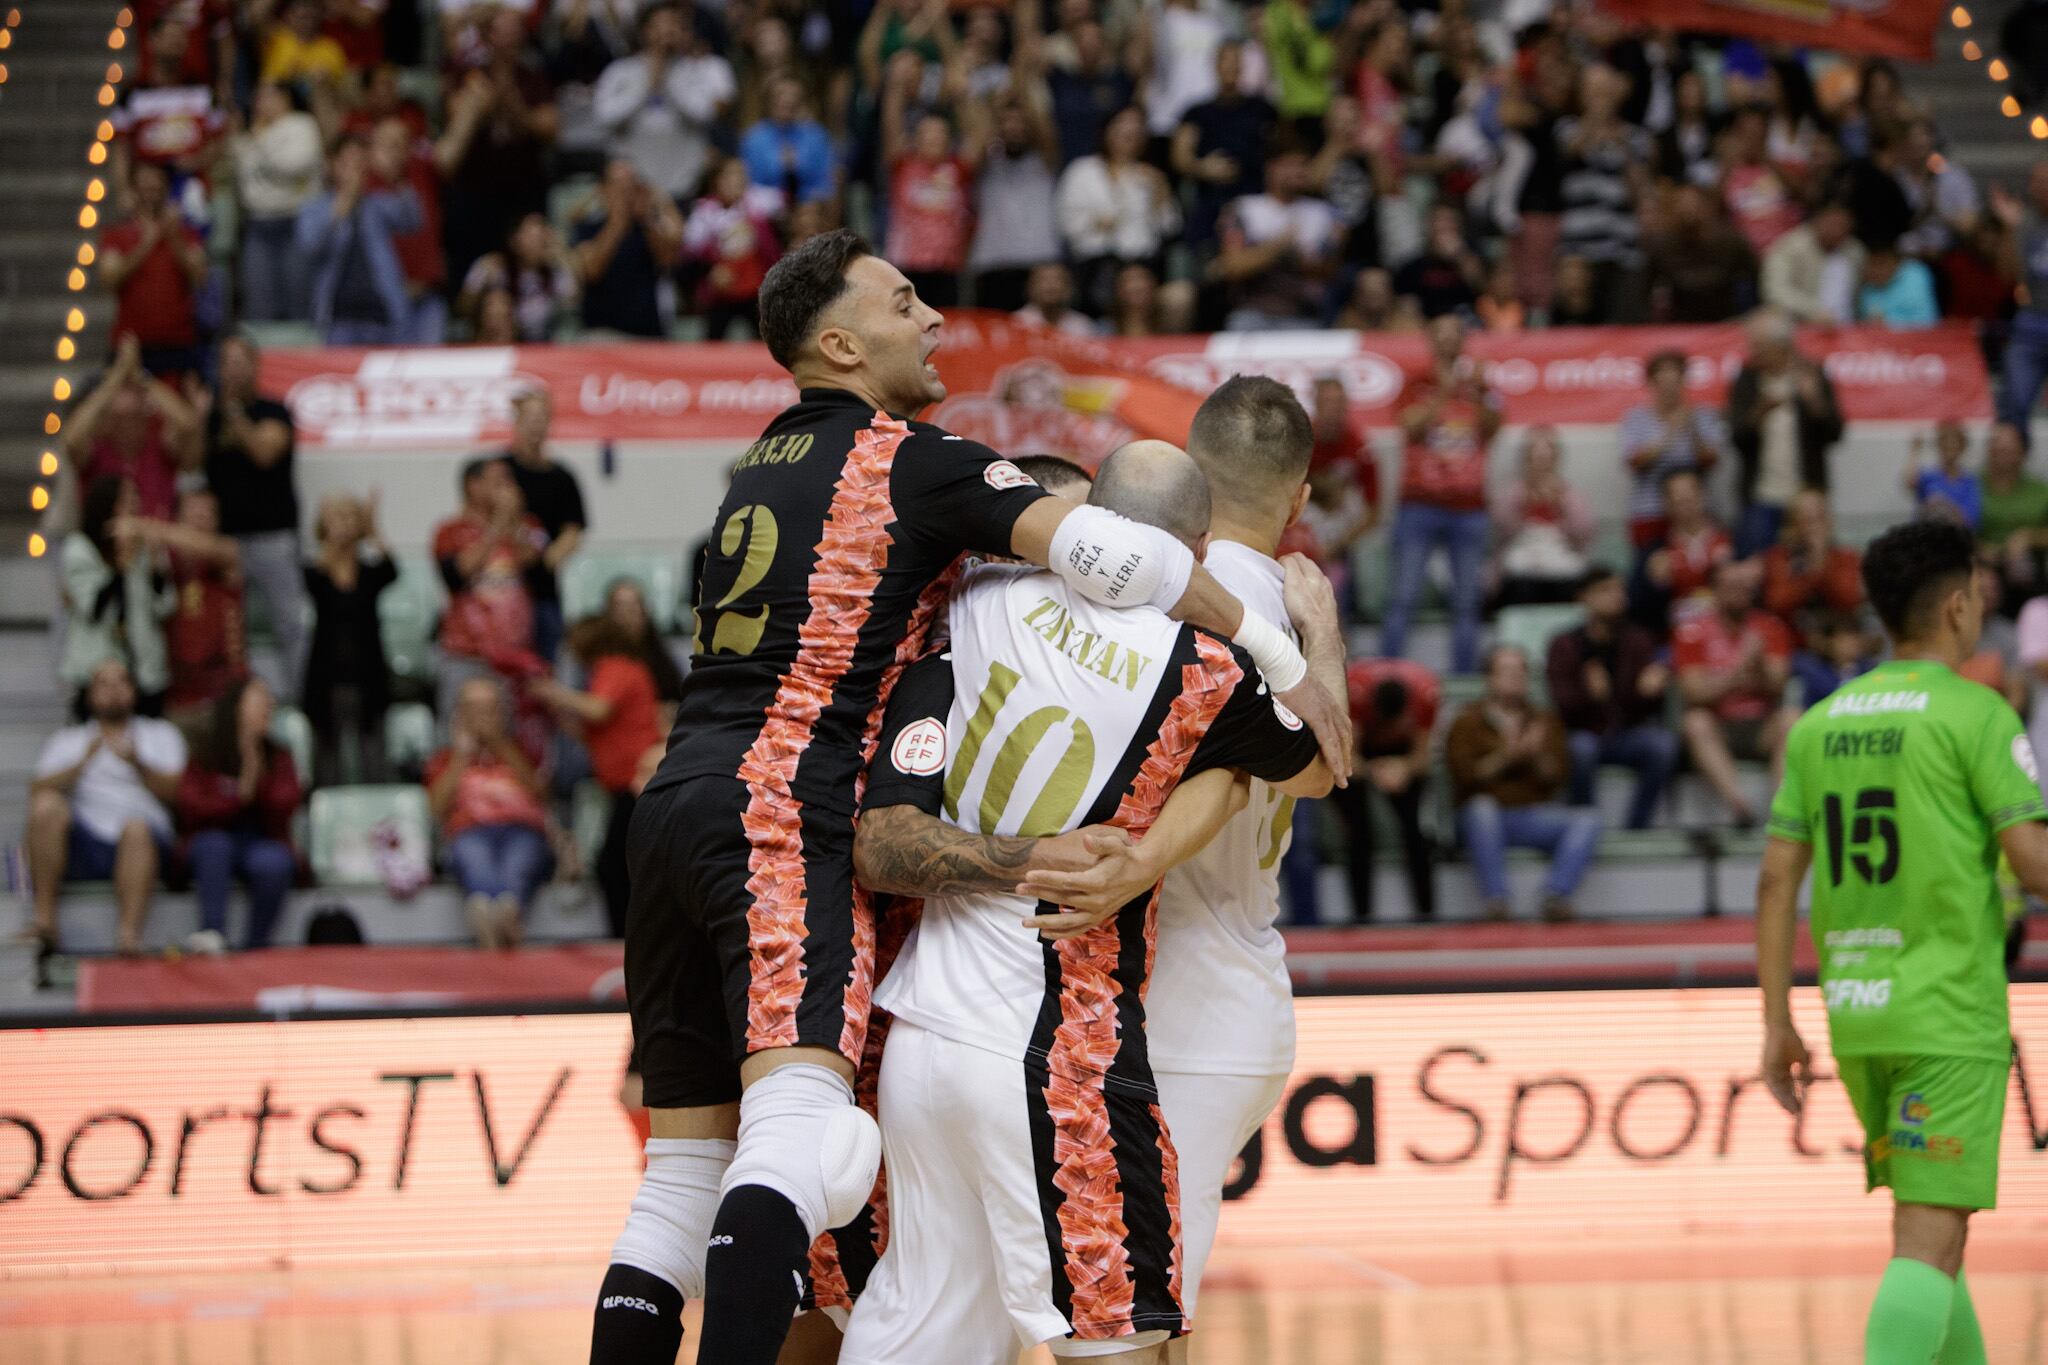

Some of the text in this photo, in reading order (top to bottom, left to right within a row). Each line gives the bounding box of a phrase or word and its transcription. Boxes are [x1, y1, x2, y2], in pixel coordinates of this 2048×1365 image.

[692, 504, 778, 656] 2
[1078, 545, 1104, 575] GALA
[1097, 567, 1110, 578] Y
[1104, 552, 1142, 600] VALERIA
[943, 660, 1096, 838] 10
[1823, 786, 1903, 888] 15
